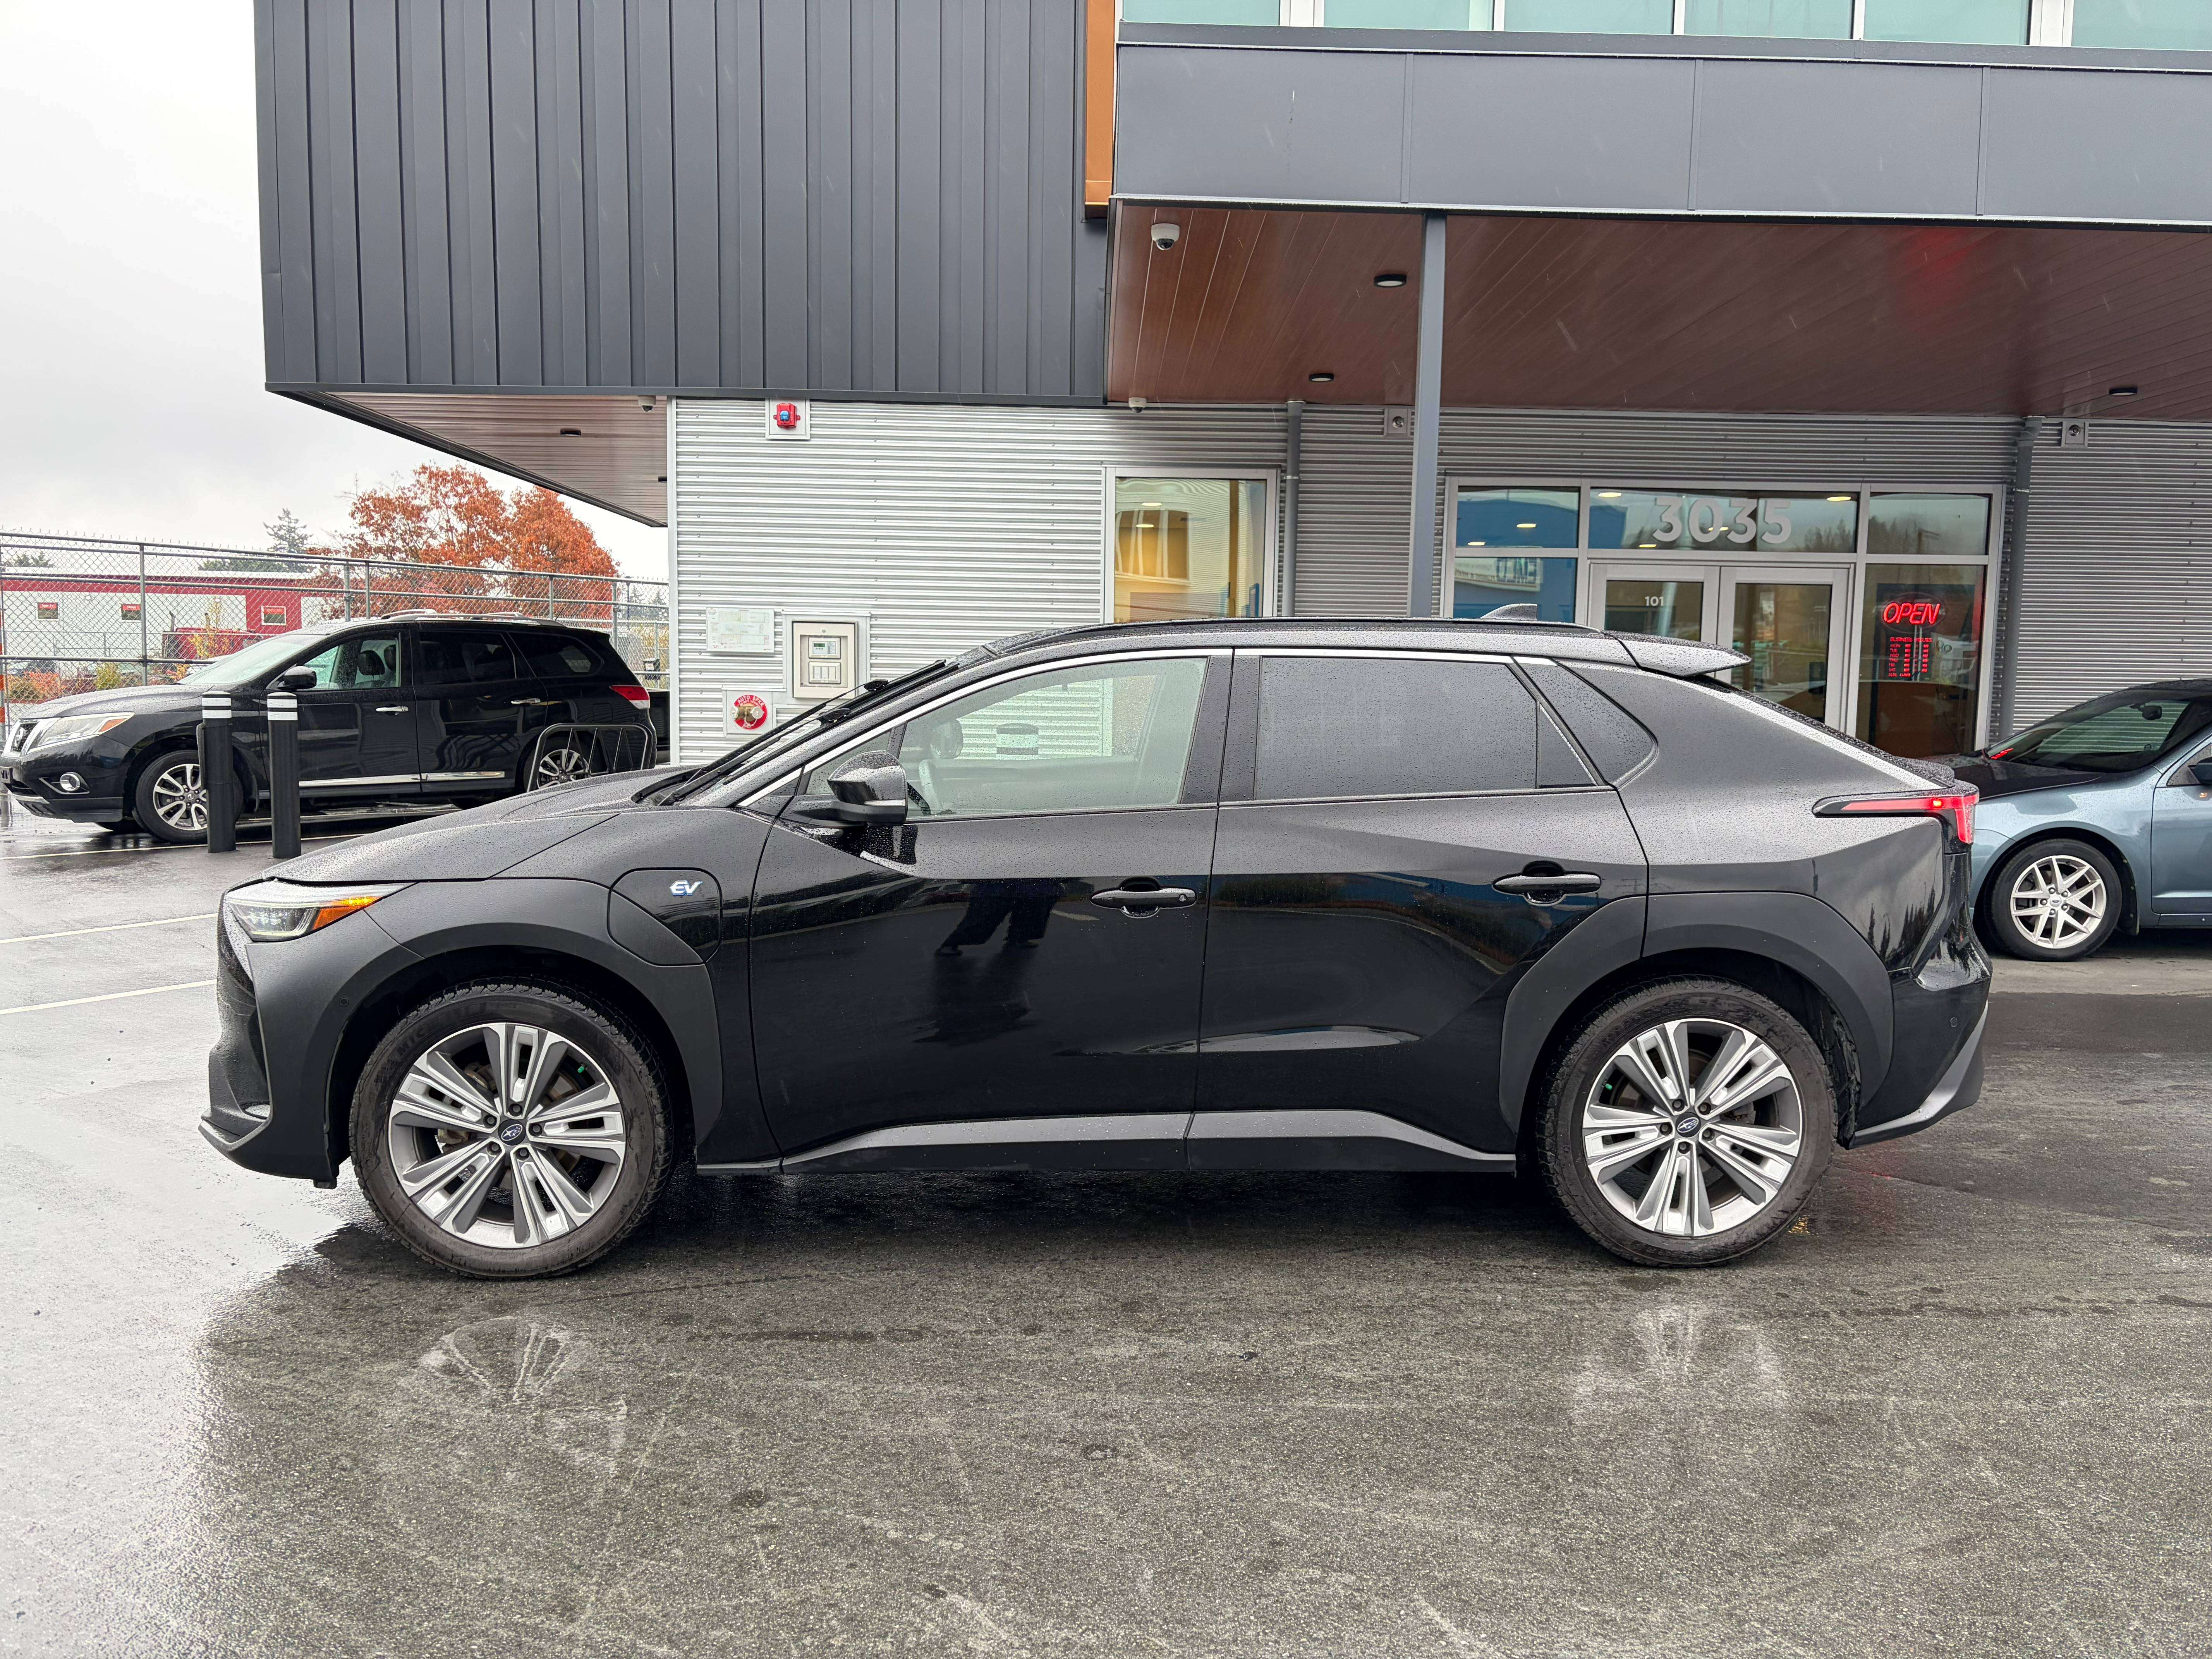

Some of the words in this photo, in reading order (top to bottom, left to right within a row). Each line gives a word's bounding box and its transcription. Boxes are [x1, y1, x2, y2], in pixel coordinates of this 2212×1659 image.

[1652, 498, 1791, 544] 3035
[1645, 596, 1664, 606] 101
[1884, 603, 1941, 625] OPEN
[669, 880, 703, 896] EV
